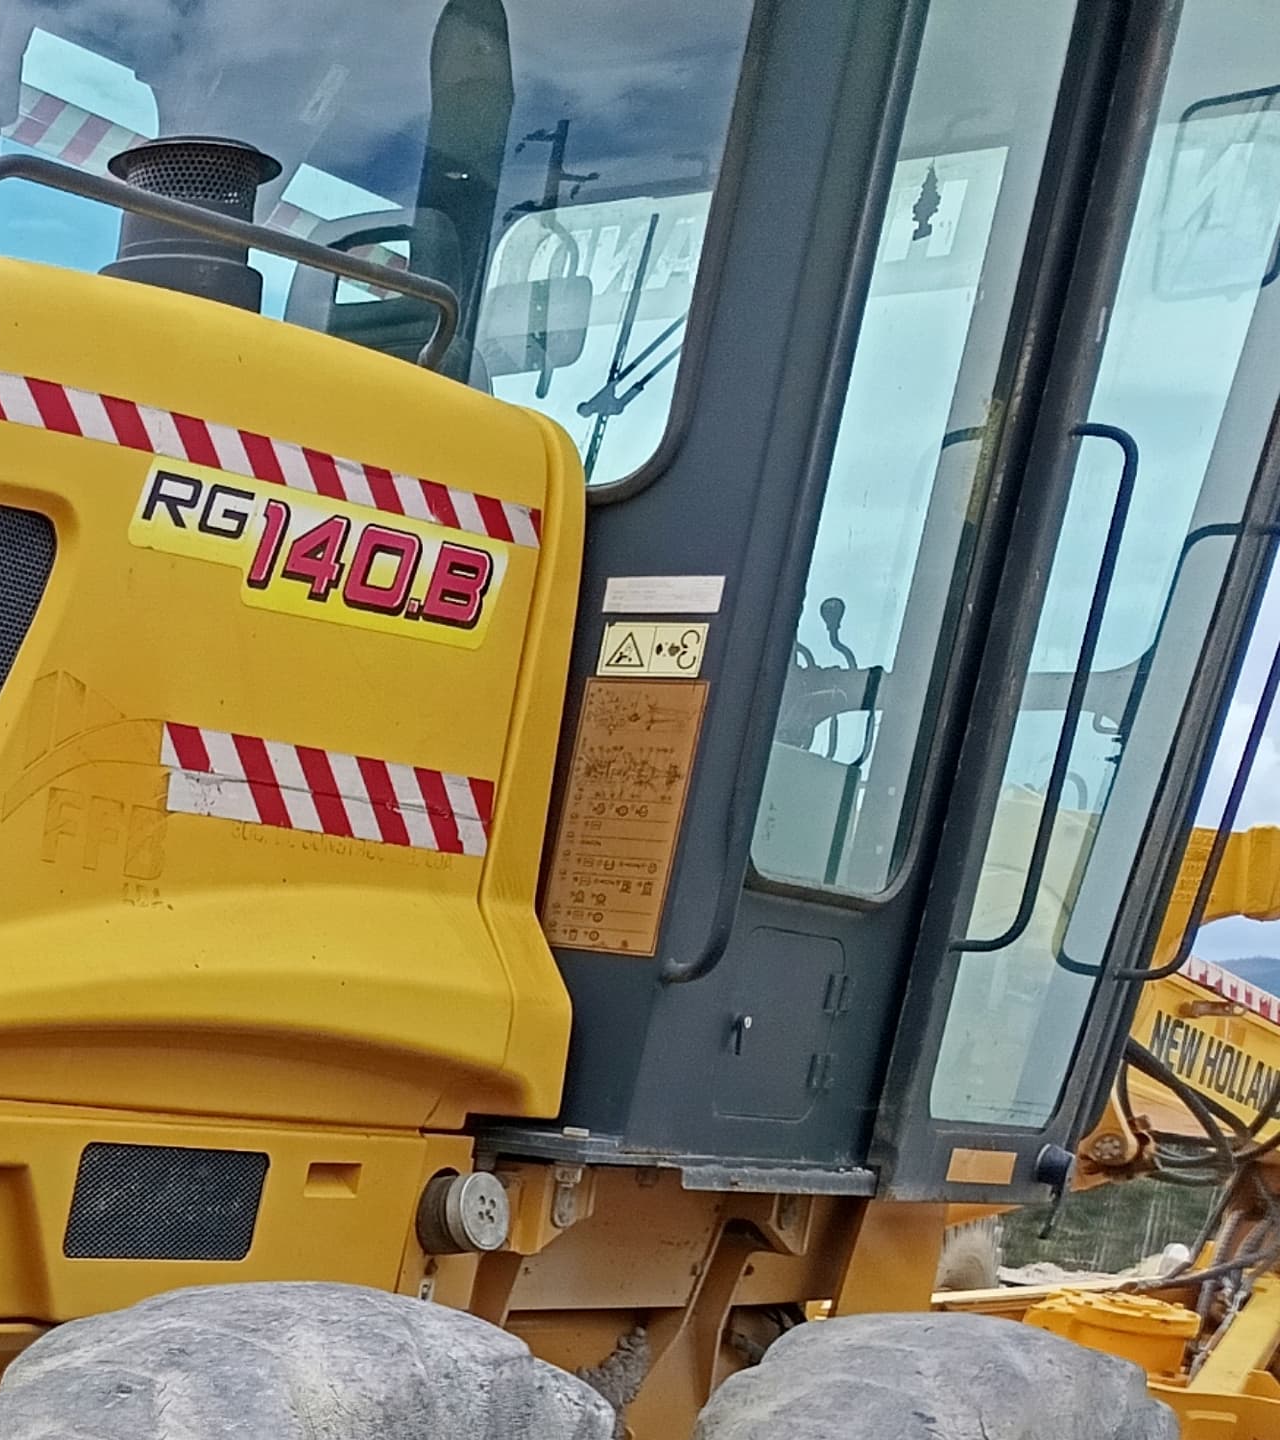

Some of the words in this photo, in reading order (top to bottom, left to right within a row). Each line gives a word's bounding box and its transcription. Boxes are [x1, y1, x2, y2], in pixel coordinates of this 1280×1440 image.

[142, 470, 256, 540] RG
[246, 498, 494, 630] 140.B
[1149, 1009, 1205, 1079] NEW
[1198, 1035, 1280, 1119] HOLLAN
